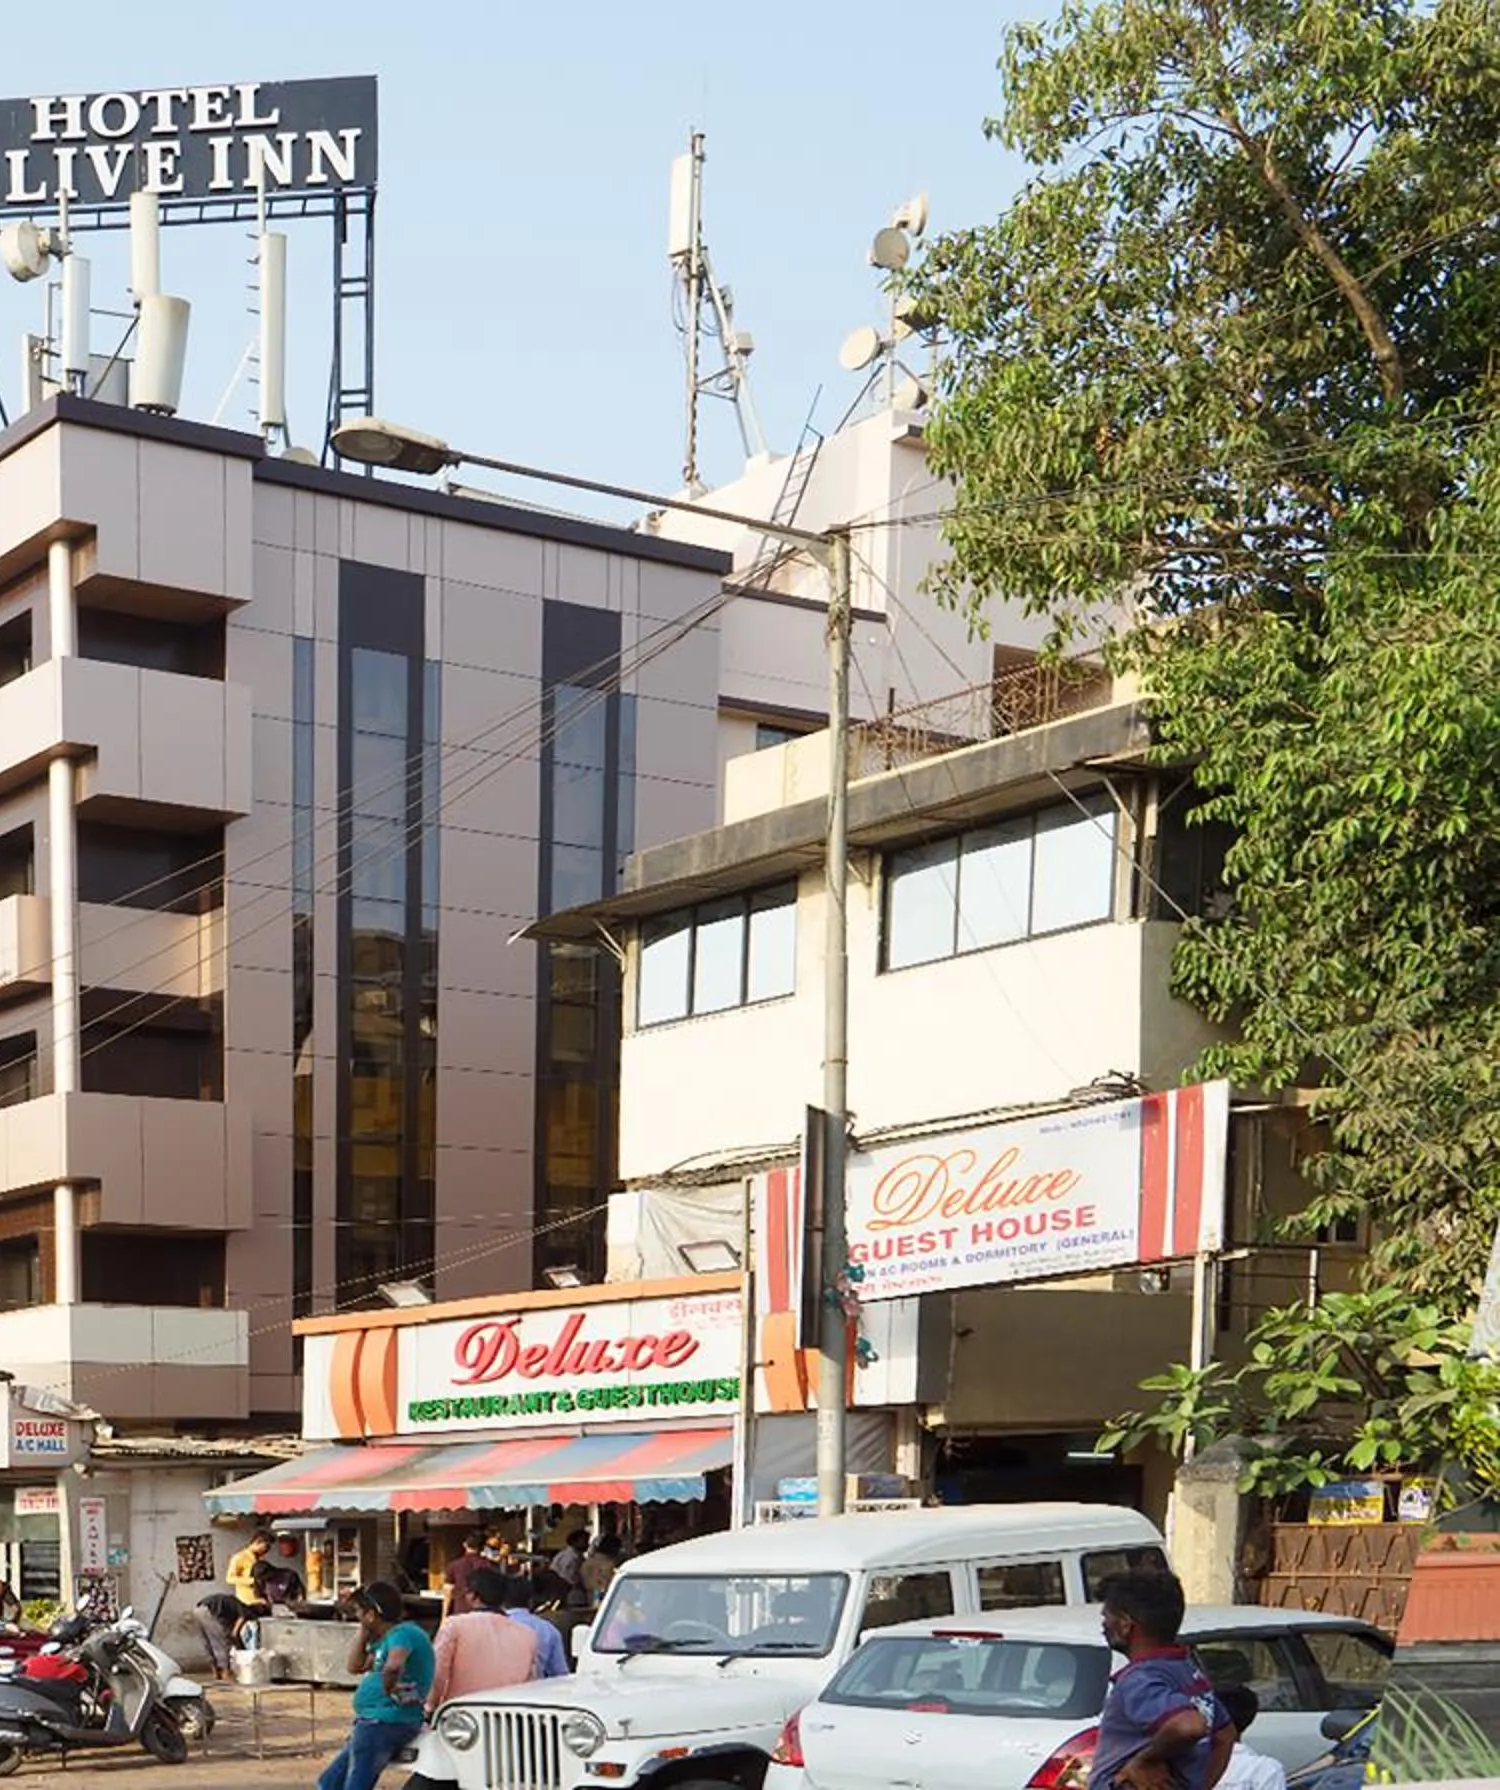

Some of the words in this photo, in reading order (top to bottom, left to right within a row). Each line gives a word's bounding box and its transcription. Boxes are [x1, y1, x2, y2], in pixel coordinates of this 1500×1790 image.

[30, 83, 280, 141] HOTEL
[208, 128, 363, 190] INN
[865, 1147, 1082, 1231] Deluxe
[848, 1228, 959, 1264] GUEST
[971, 1205, 1097, 1245] HOUSE
[900, 1257, 947, 1273] ROOMS
[965, 1242, 1047, 1264] DORMITORY
[451, 1313, 699, 1386] Deluxe
[15, 1421, 66, 1437] DELUXE
[409, 1391, 557, 1422] RESTAURANT
[37, 1439, 66, 1452] HALL
